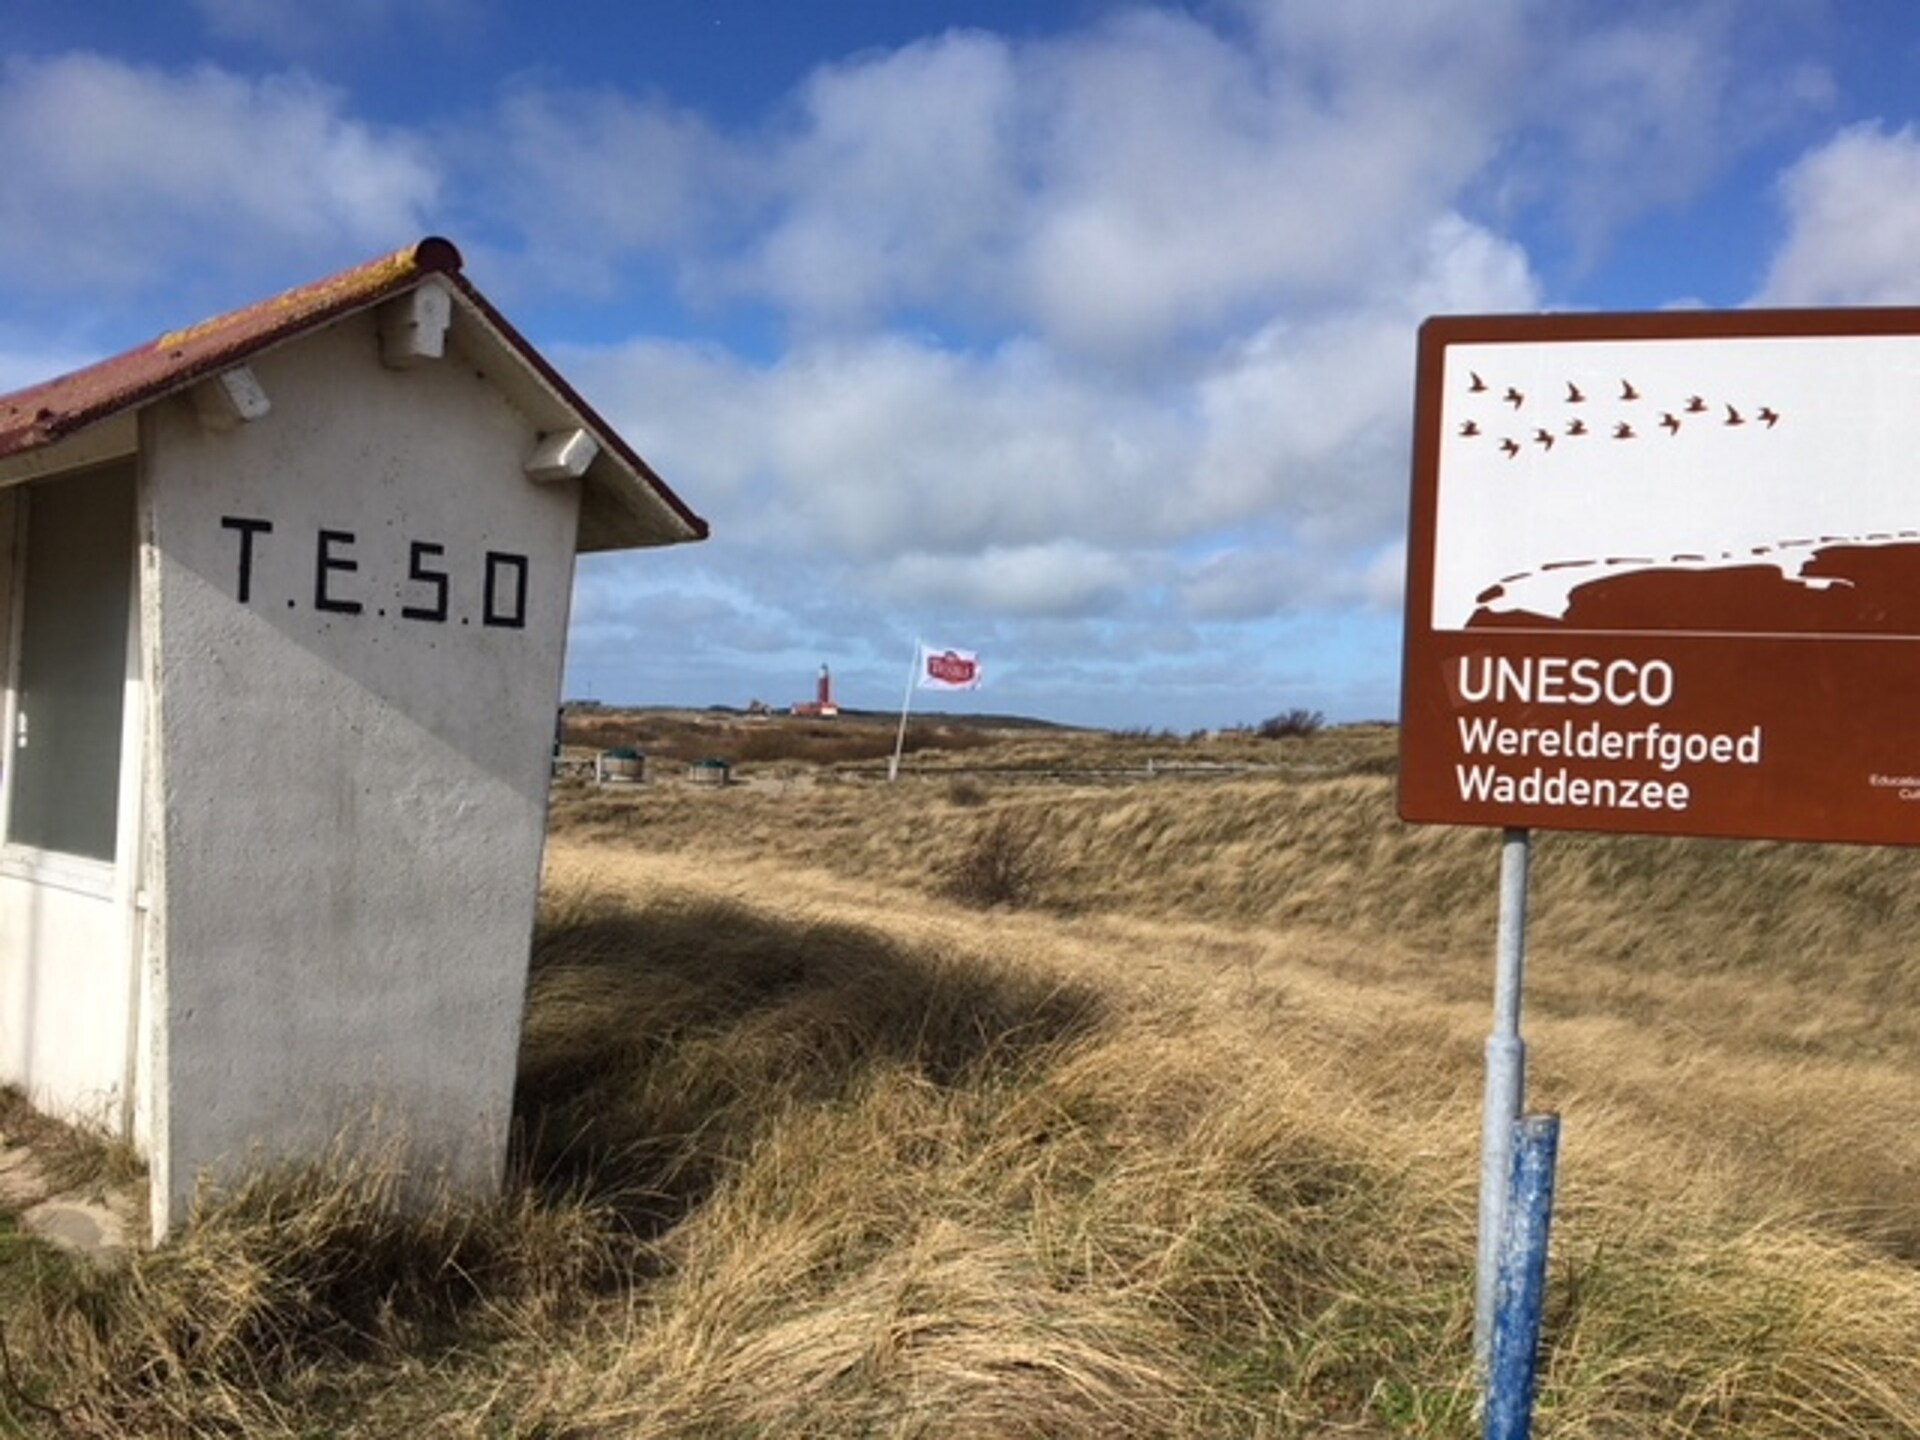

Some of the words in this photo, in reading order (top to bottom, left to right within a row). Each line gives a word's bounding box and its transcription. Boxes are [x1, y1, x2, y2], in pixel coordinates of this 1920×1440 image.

[1459, 656, 1673, 705] UNESCO
[1457, 716, 1761, 771] Werelderfgoed
[1456, 764, 1690, 810] Waddenzee
